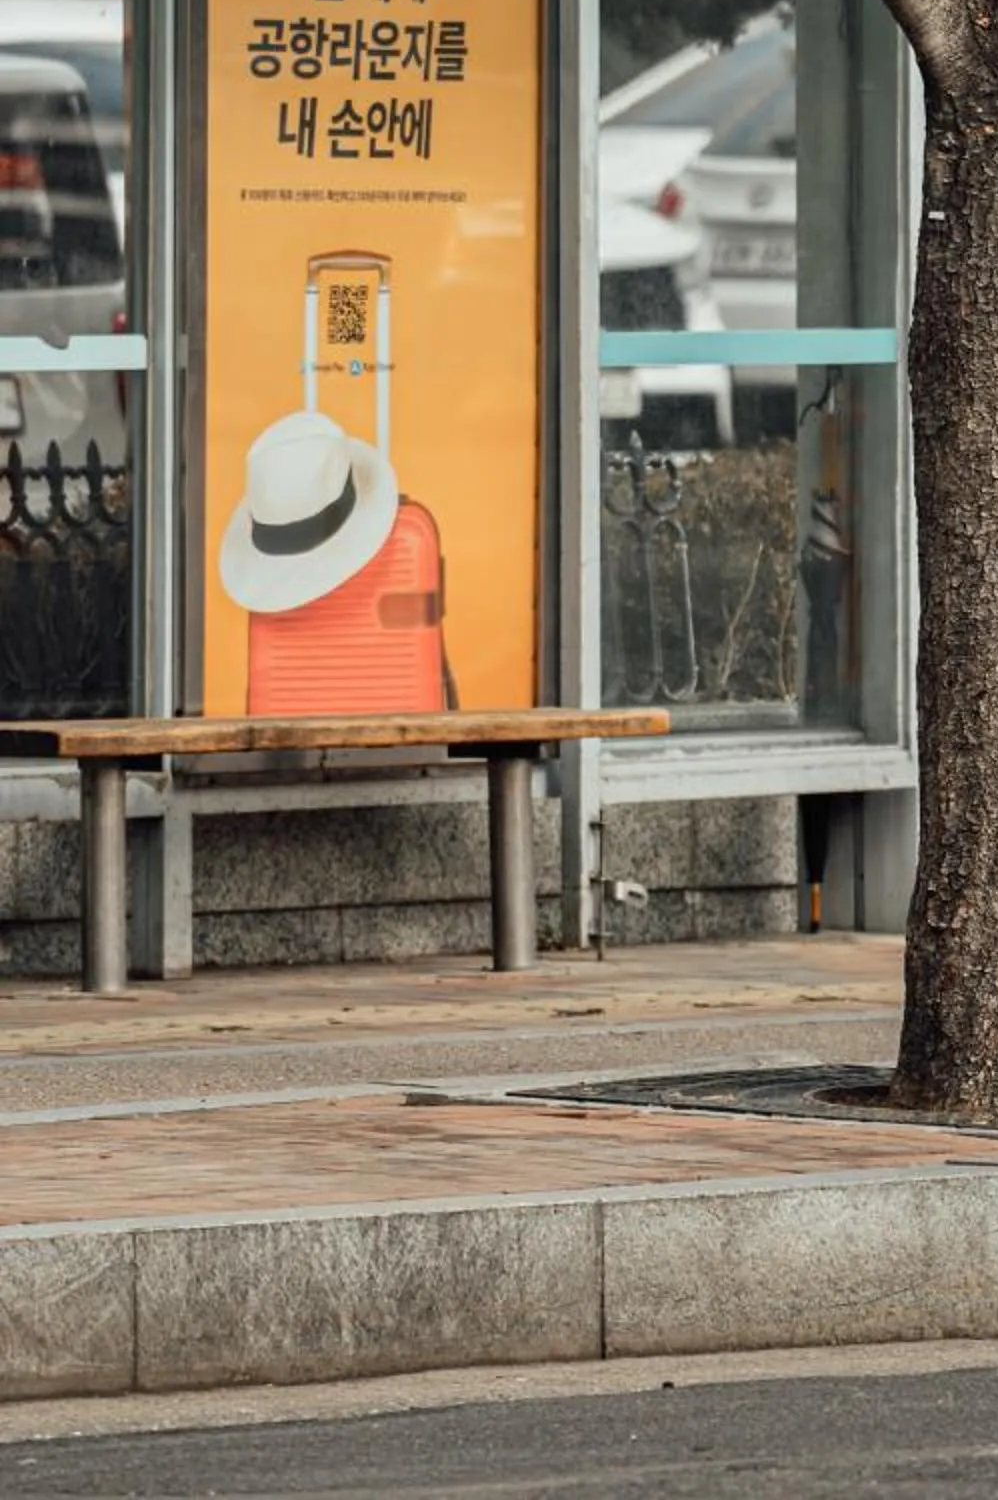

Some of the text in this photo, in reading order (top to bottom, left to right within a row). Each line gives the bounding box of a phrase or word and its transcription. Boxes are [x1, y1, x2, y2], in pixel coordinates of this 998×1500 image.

[247, 17, 468, 82] 공항라운지를
[278, 97, 433, 160] 내 손안에
